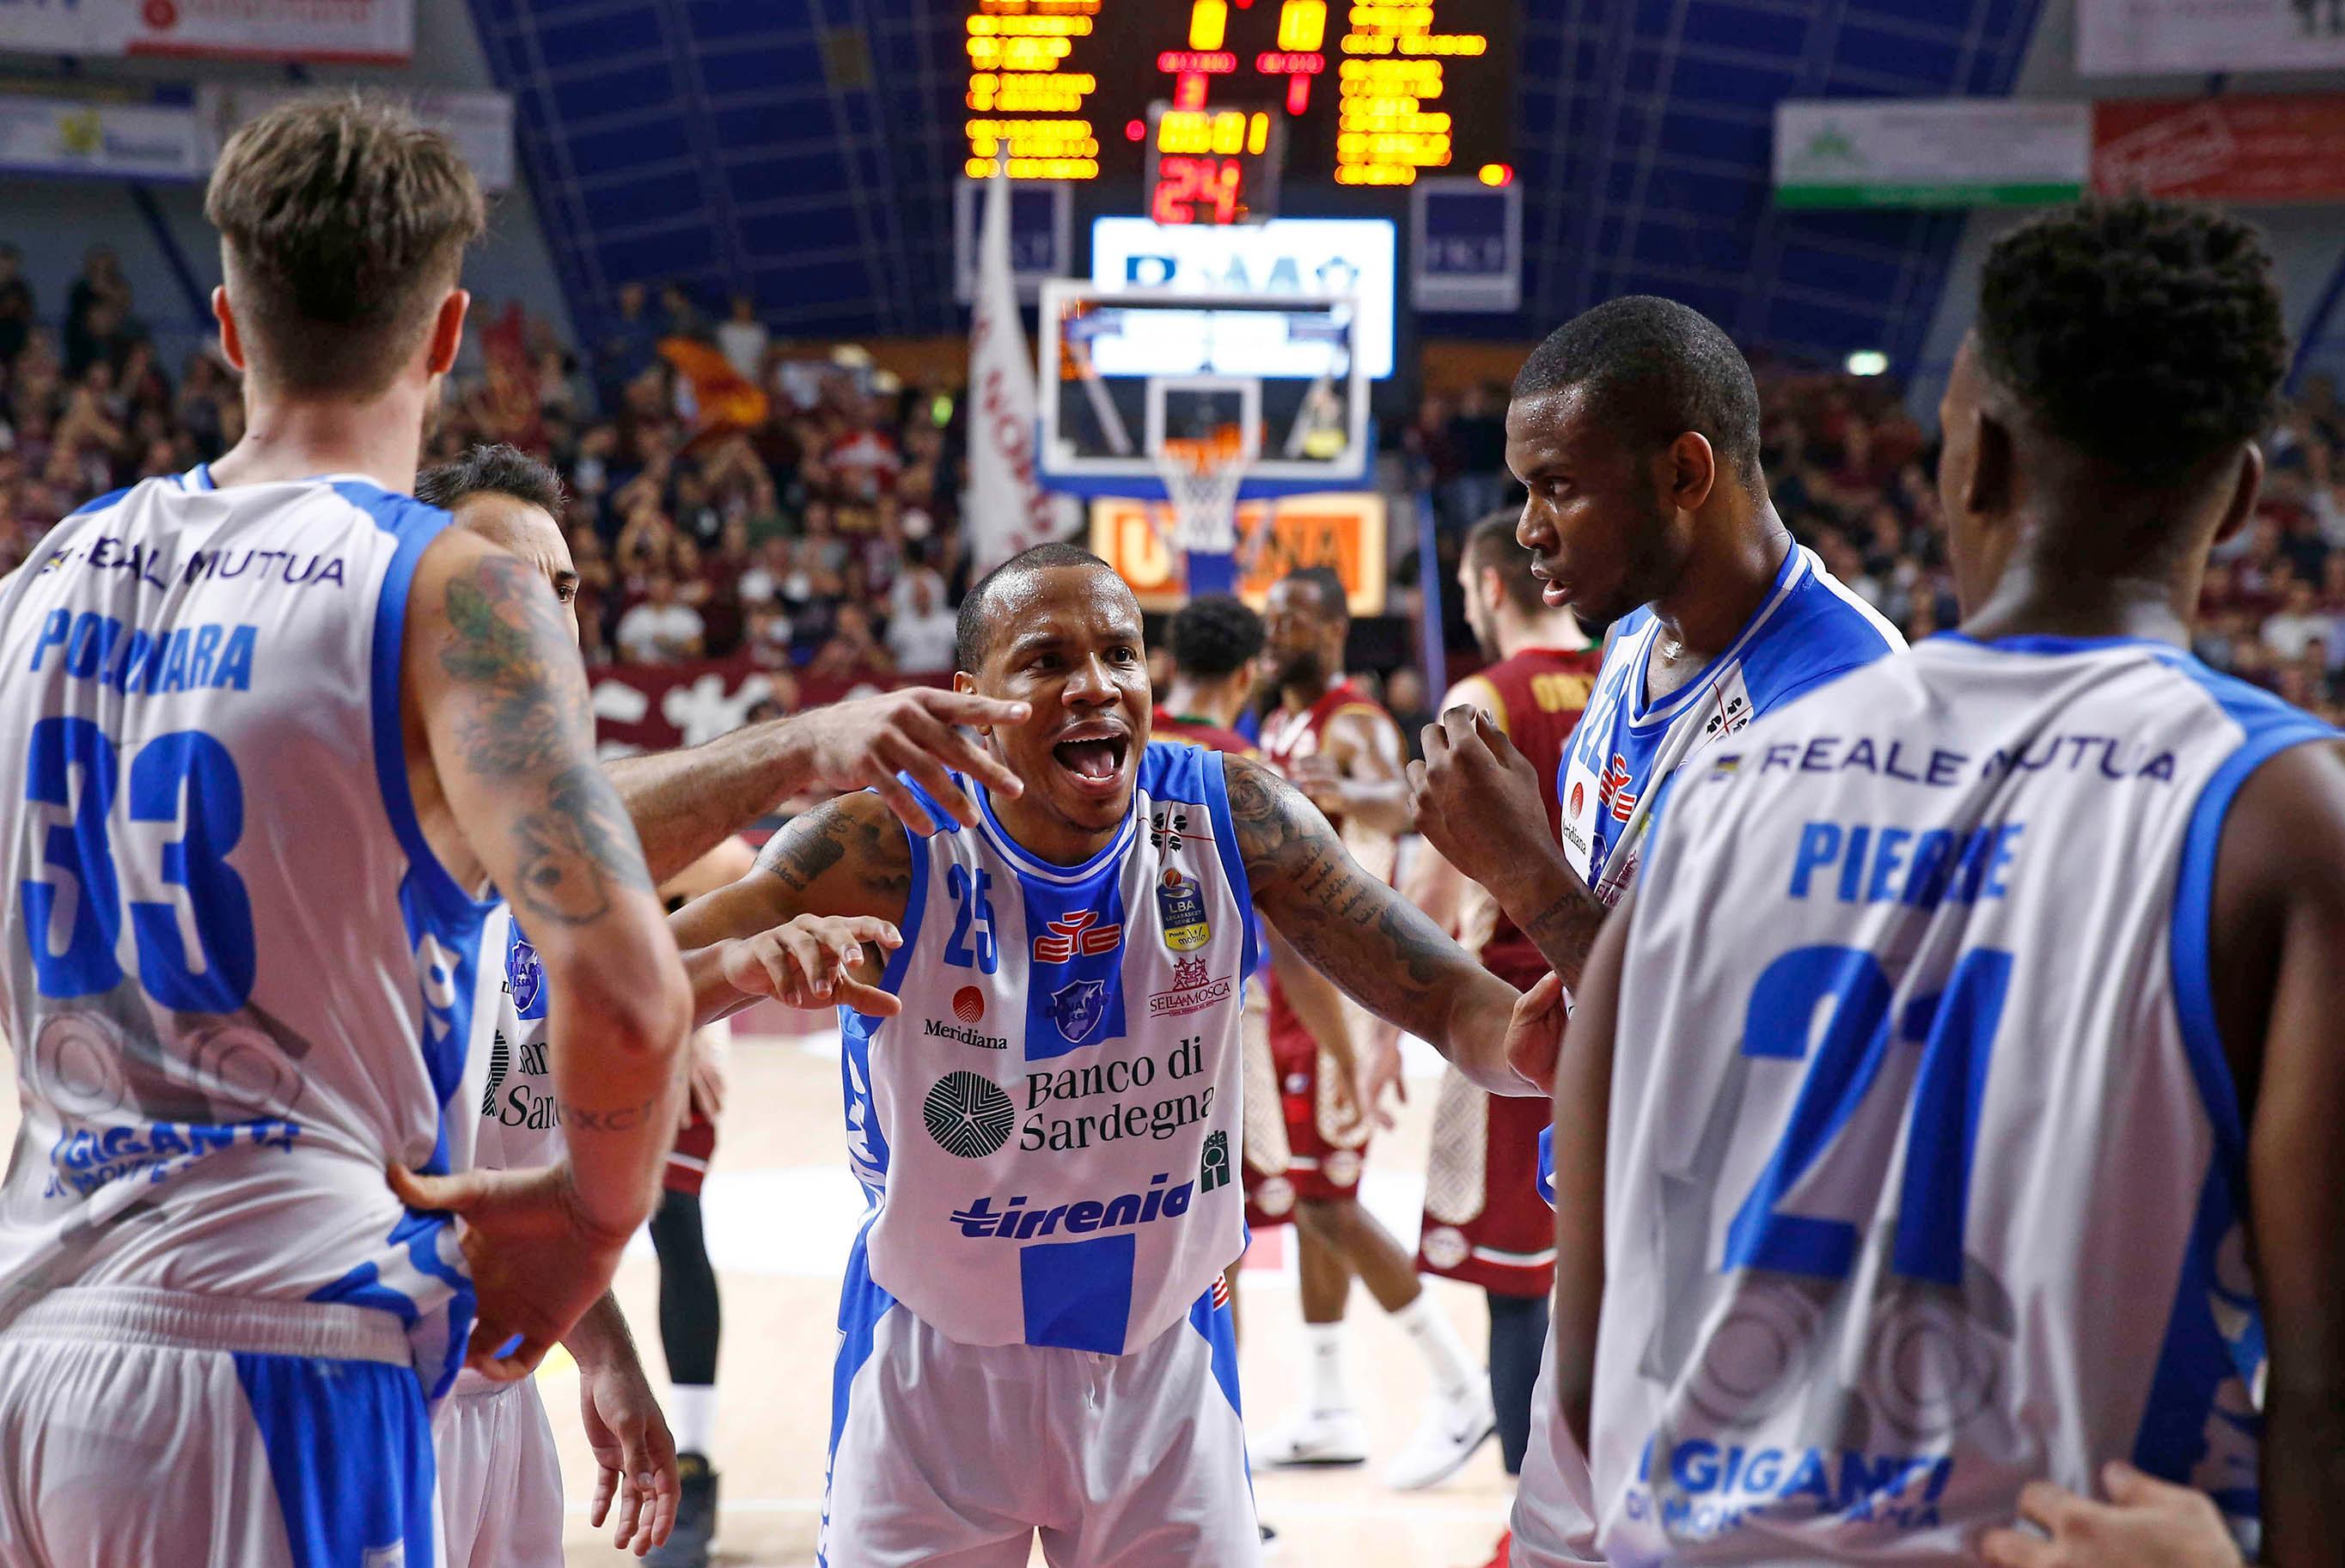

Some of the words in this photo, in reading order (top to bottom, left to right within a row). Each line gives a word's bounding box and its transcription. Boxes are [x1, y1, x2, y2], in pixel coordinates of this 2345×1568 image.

[1152, 156, 1241, 223] 24
[183, 549, 345, 588] MUTUA
[1760, 737, 1969, 787] REALE
[21, 717, 257, 1015] 33
[943, 863, 998, 974] 25
[1169, 900, 1196, 913] LBA
[1178, 925, 1206, 945] mobile
[924, 1019, 1008, 1051] Meridiana
[1025, 1056, 1155, 1111] Banco
[1168, 1036, 1204, 1079] di
[1019, 1086, 1214, 1151] Sardegna
[1721, 938, 2014, 1285] 21
[950, 1172, 1194, 1240] tirrenia
